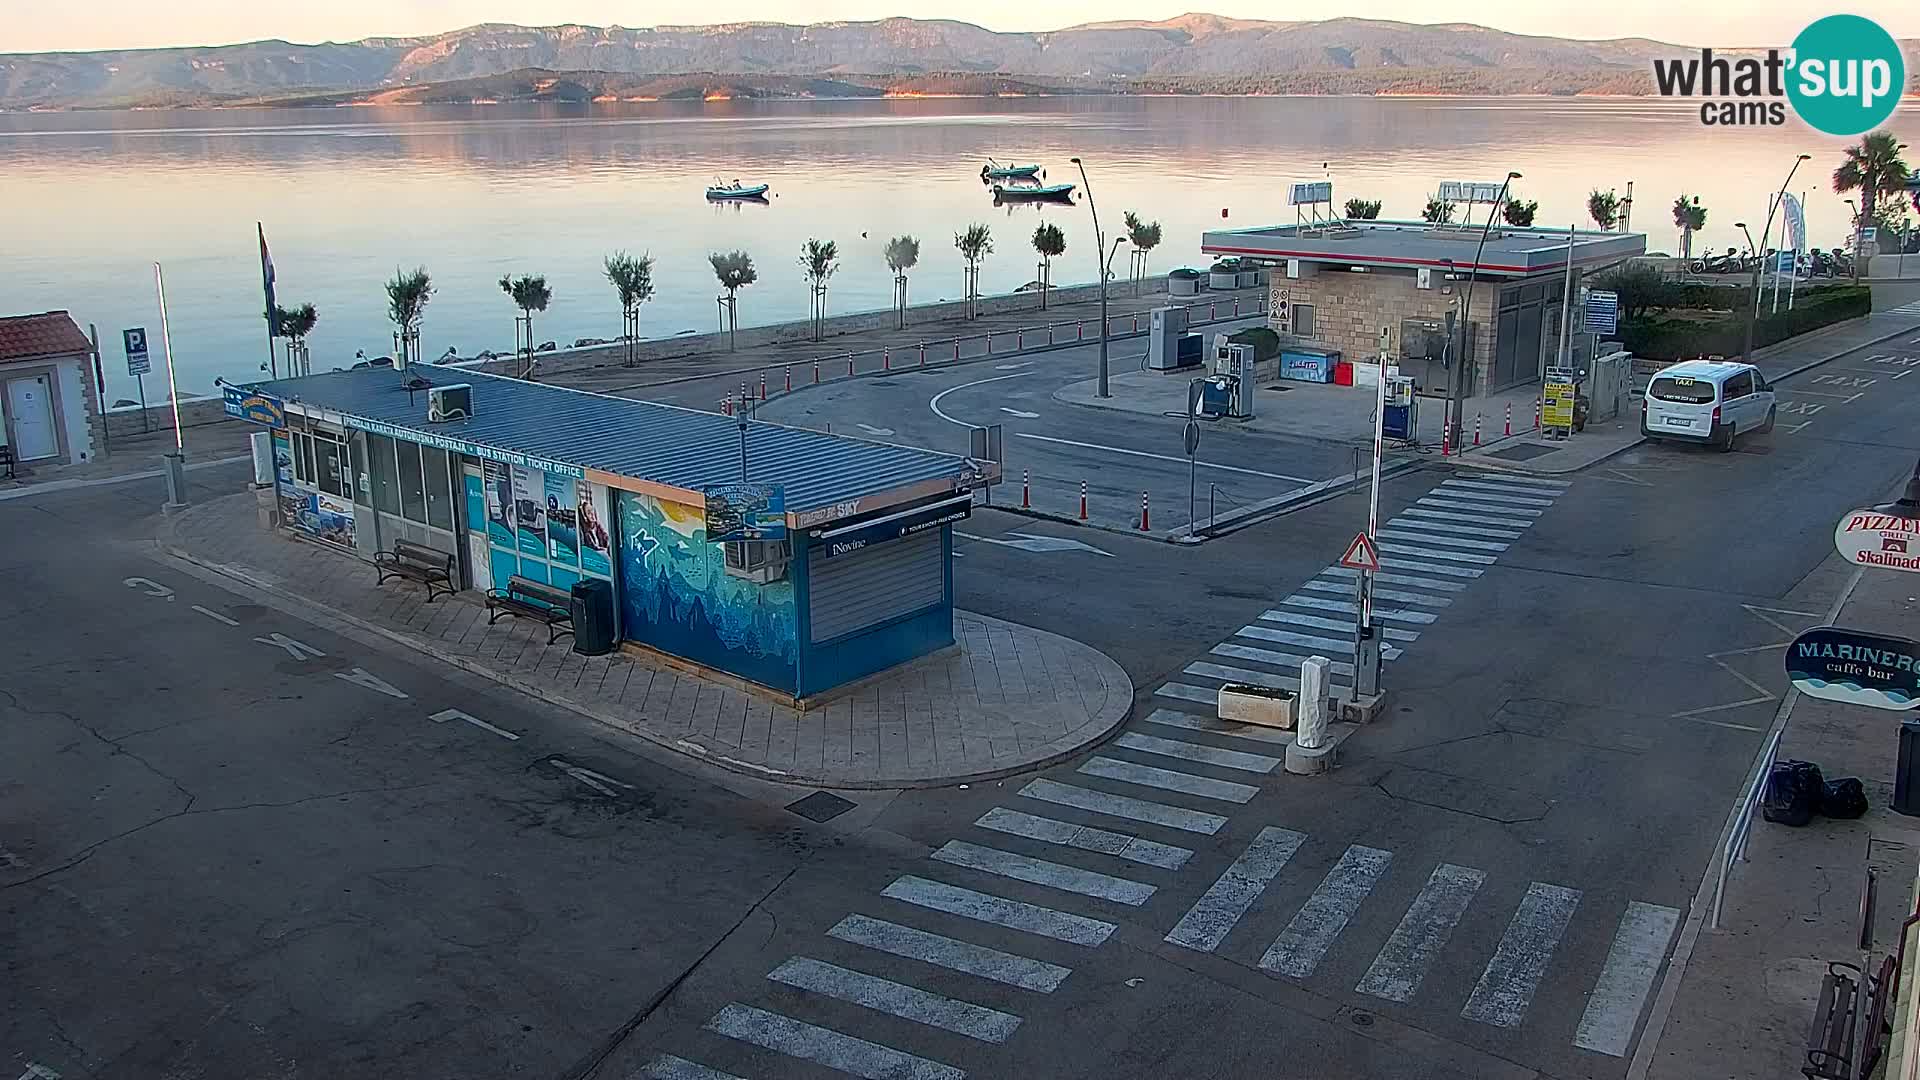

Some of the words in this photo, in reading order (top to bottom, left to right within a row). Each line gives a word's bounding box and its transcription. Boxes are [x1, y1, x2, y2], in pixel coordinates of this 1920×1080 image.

[128, 332, 142, 350] P
[1674, 378, 1694, 387] TAXI
[394, 427, 435, 443] AUTOBUSNA
[435, 436, 466, 452] POSTAJA
[476, 446, 492, 459] BUS
[492, 449, 525, 466] STATION
[526, 457, 553, 471] TICKET
[554, 464, 581, 478] OFFICE
[1879, 531, 1914, 541] GRILL
[1826, 662, 1863, 676] caffe
[1867, 665, 1894, 681] bar
